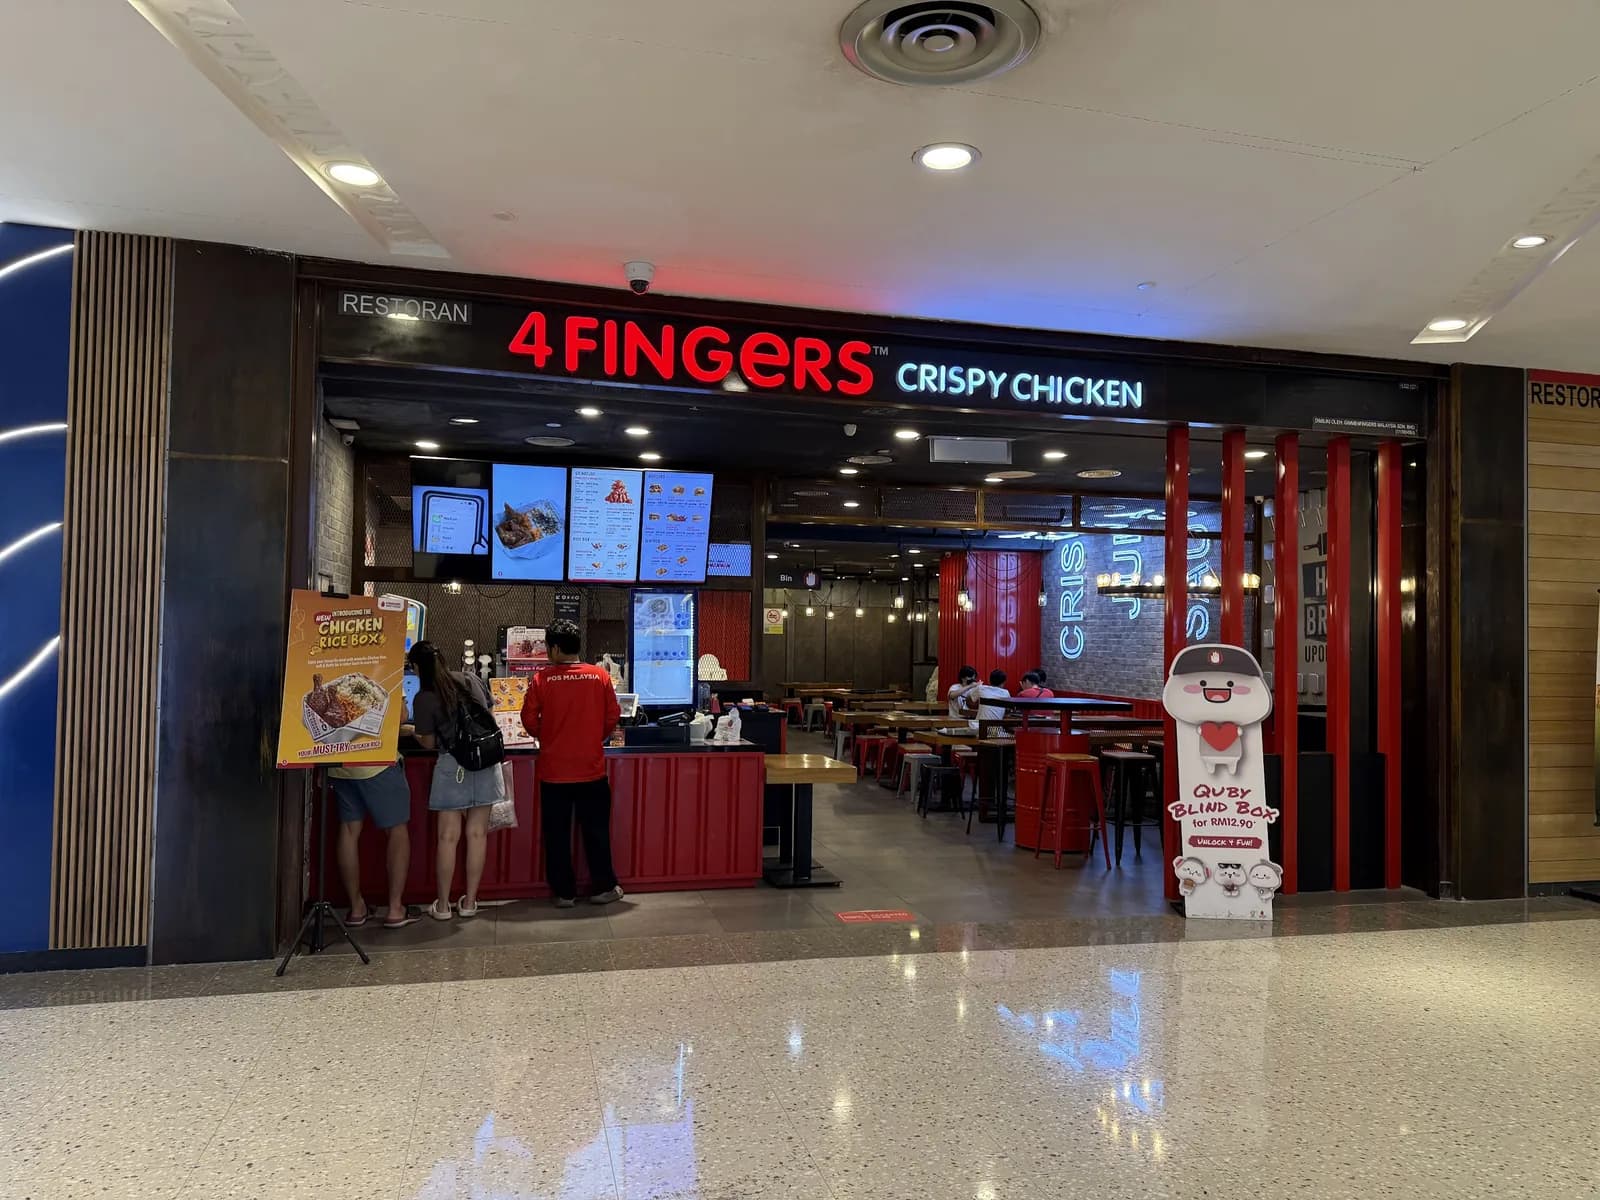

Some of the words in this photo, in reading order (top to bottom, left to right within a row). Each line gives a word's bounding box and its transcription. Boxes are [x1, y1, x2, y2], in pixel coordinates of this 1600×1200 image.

[342, 293, 469, 322] RESTORAN
[508, 311, 553, 368] 4
[896, 362, 1009, 400] CRISPY
[1010, 371, 1143, 410] CHICKEN
[779, 574, 793, 582] Bin
[1315, 566, 1327, 597] H
[318, 617, 383, 635] CHICKEN
[319, 635, 348, 649] RICE
[352, 634, 379, 647] BOX
[1305, 645, 1328, 663] UPO
[563, 673, 600, 681] MALAYSIA
[1193, 783, 1252, 799] QUBY
[1171, 801, 1228, 818] BLIND
[1235, 801, 1277, 821] BOX
[1193, 819, 1208, 828] for
[1197, 838, 1227, 847] UNLOCK
[1236, 839, 1253, 848] FUN!
